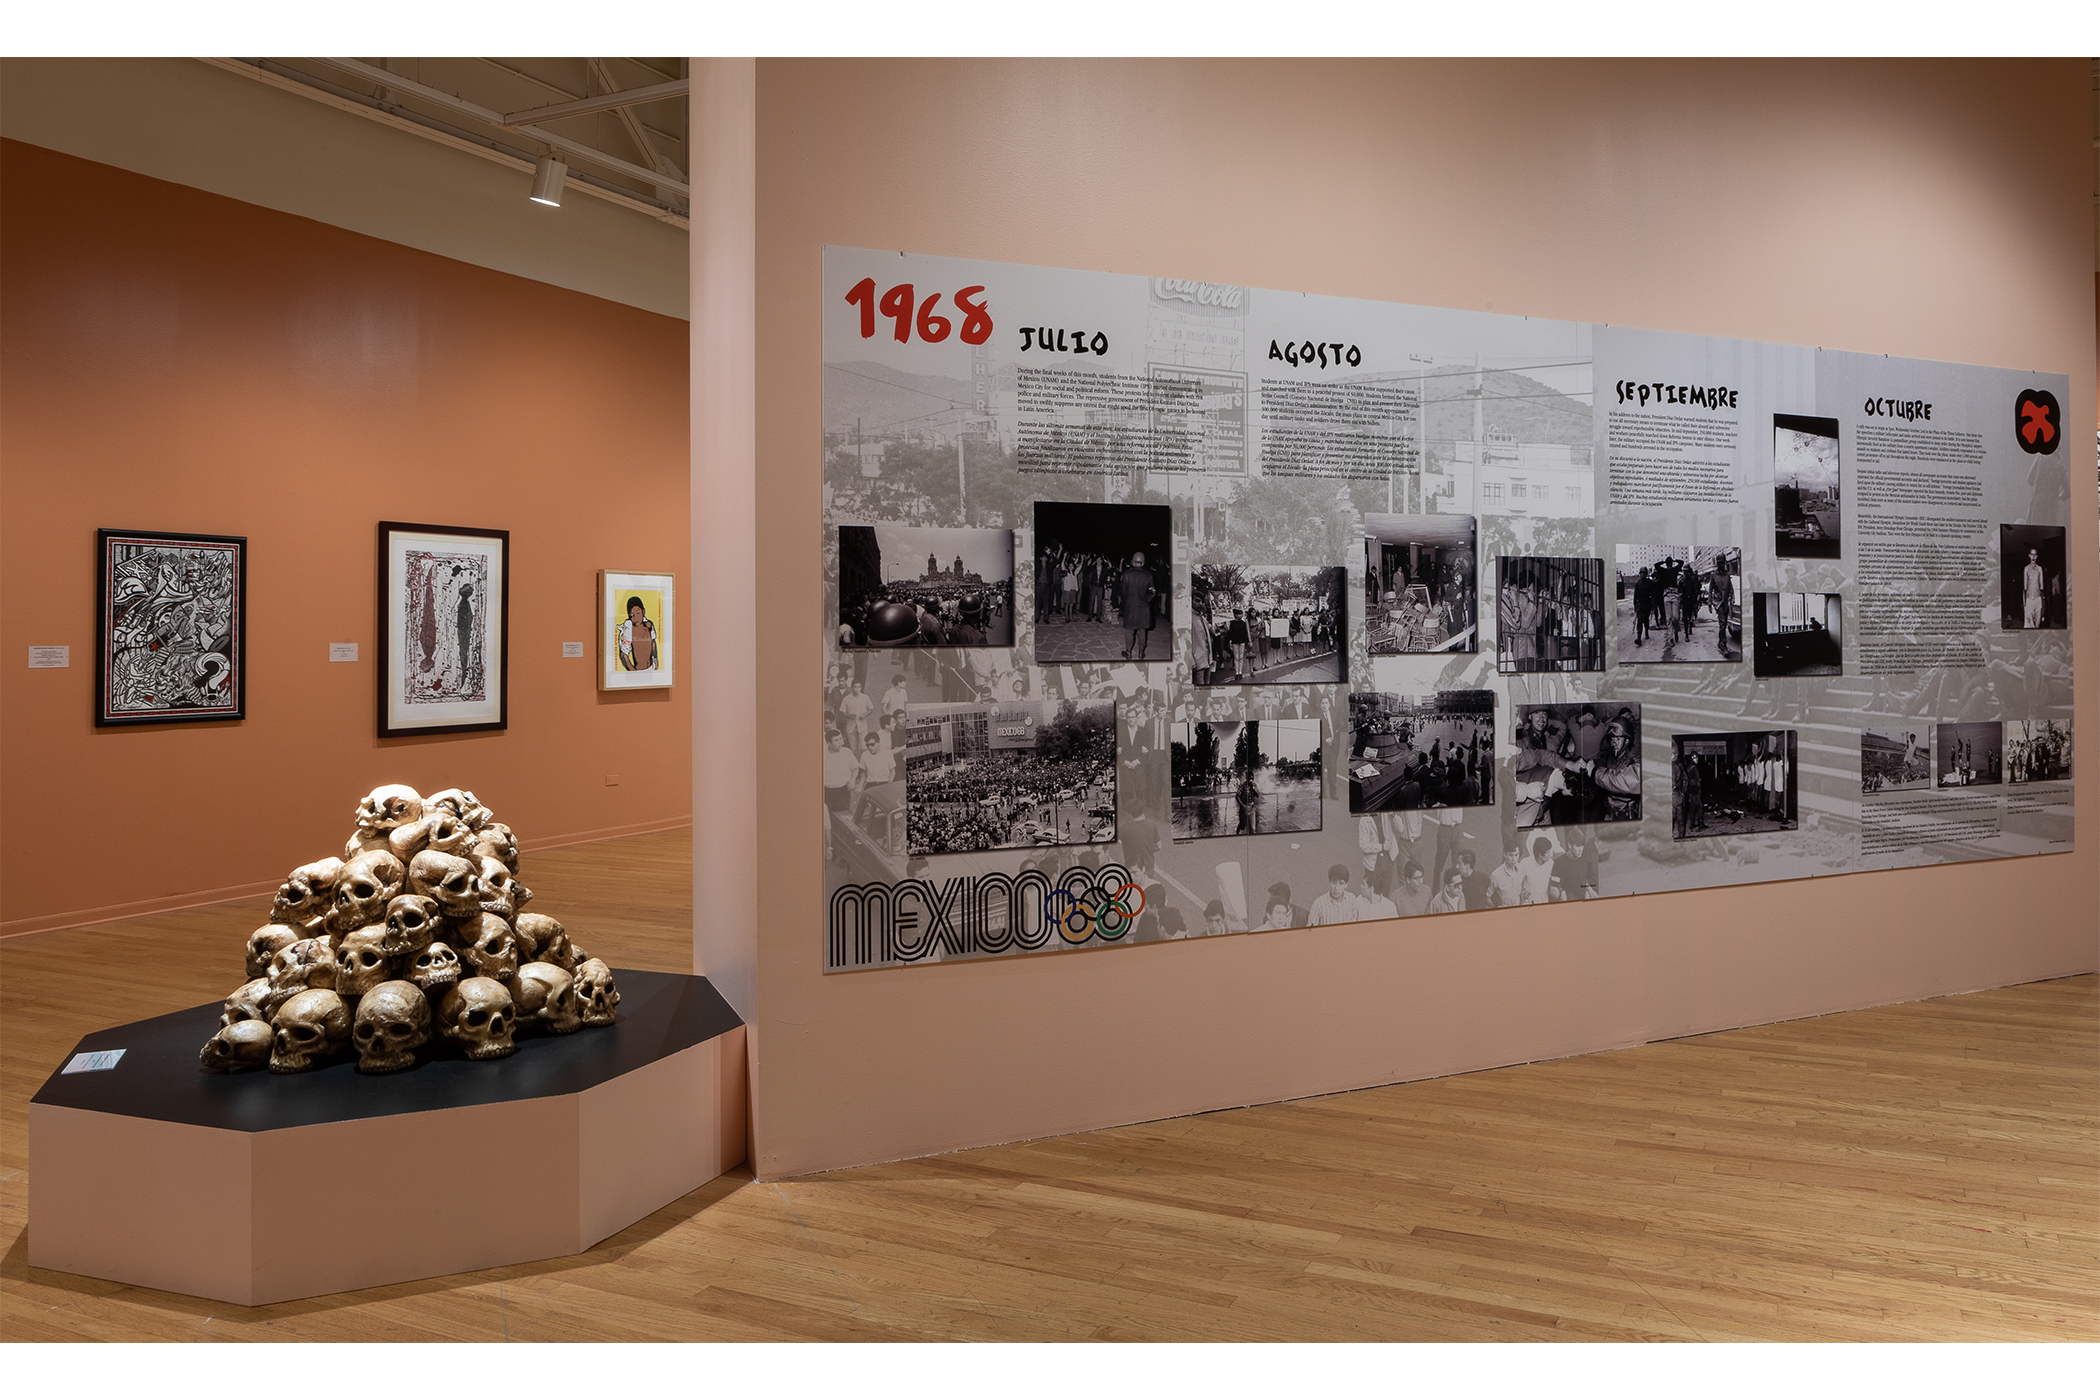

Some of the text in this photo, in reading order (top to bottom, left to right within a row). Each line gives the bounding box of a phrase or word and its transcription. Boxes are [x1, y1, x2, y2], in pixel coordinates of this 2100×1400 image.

[844, 277, 994, 346] 1968
[1018, 326, 1109, 356] JULIO
[1268, 339, 1362, 370] AGOSTO
[1041, 377, 1059, 385] (UNAM)
[1168, 385, 1198, 394] demonstrating
[1615, 379, 1739, 411] SEPTIEMBRE
[1863, 397, 1933, 423] OCTUBRE
